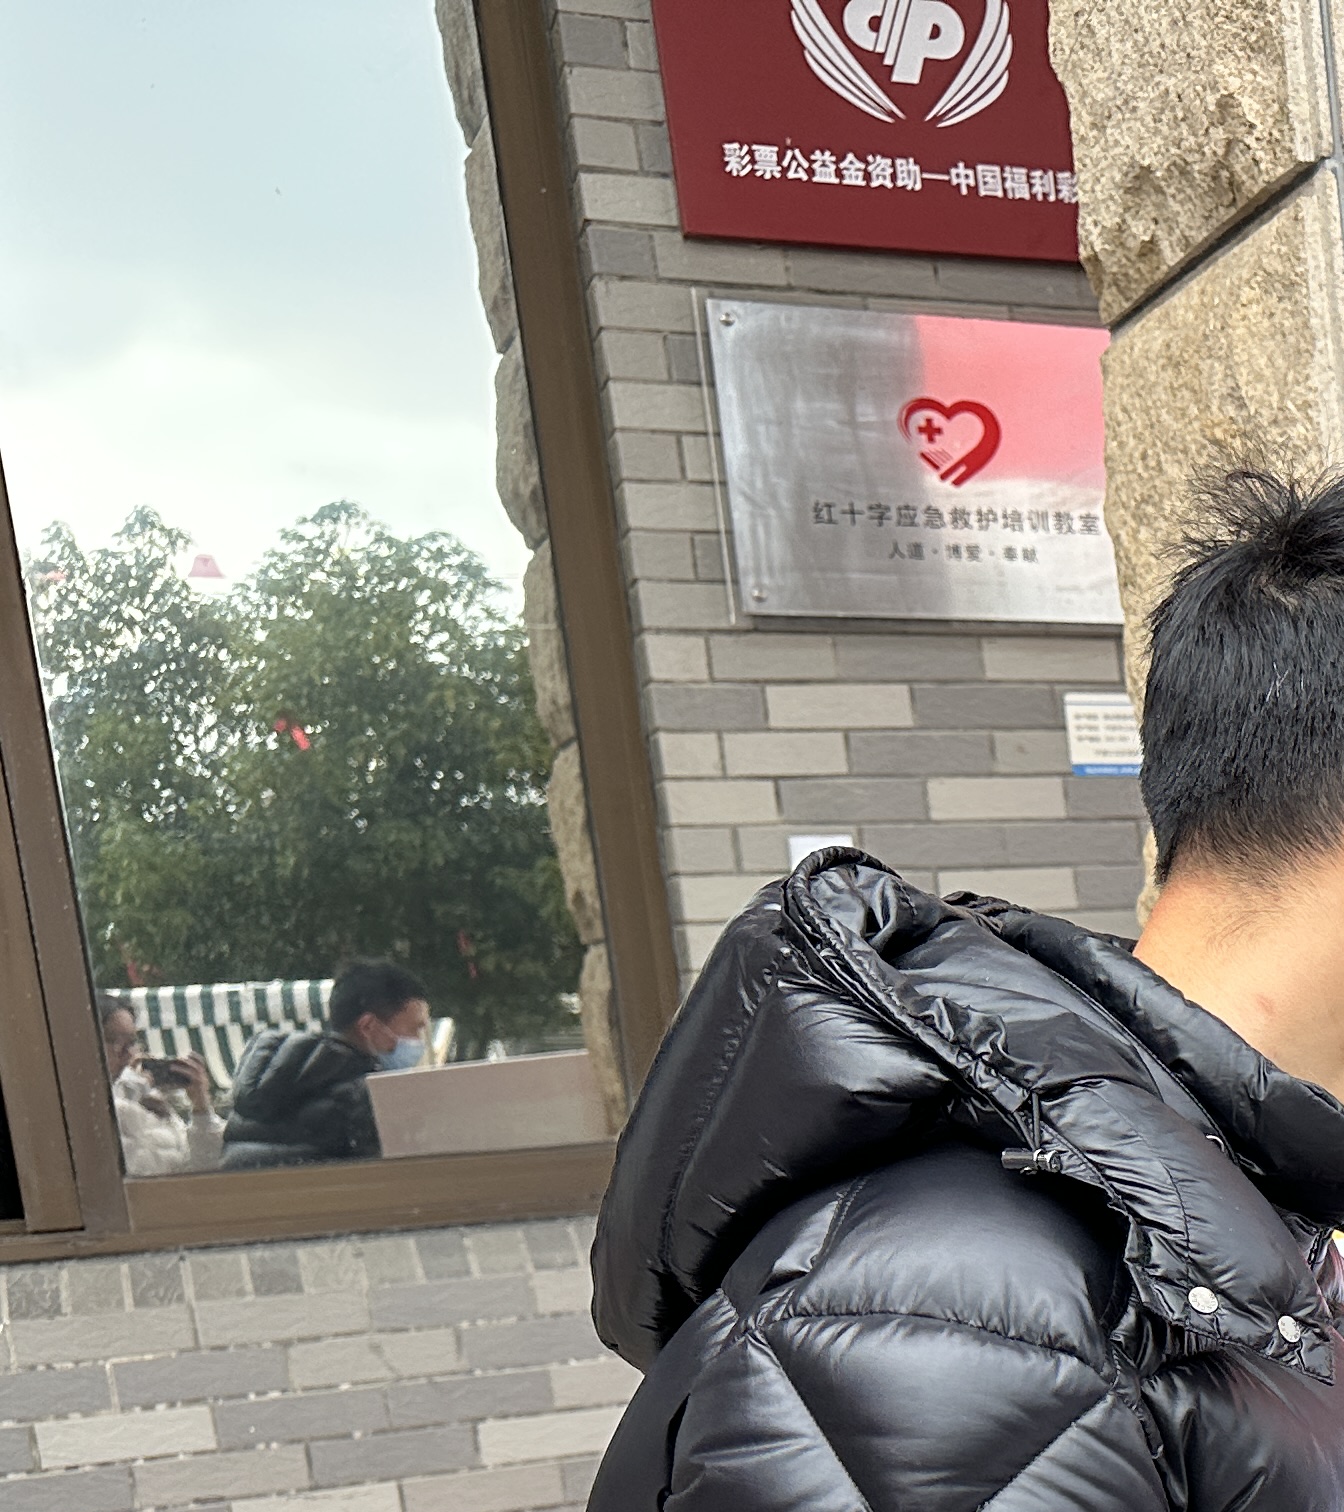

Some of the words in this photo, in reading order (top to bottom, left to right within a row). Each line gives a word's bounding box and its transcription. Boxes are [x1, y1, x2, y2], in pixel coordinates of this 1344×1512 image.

[812, 501, 1100, 535] 红十字应急救护培训教室
